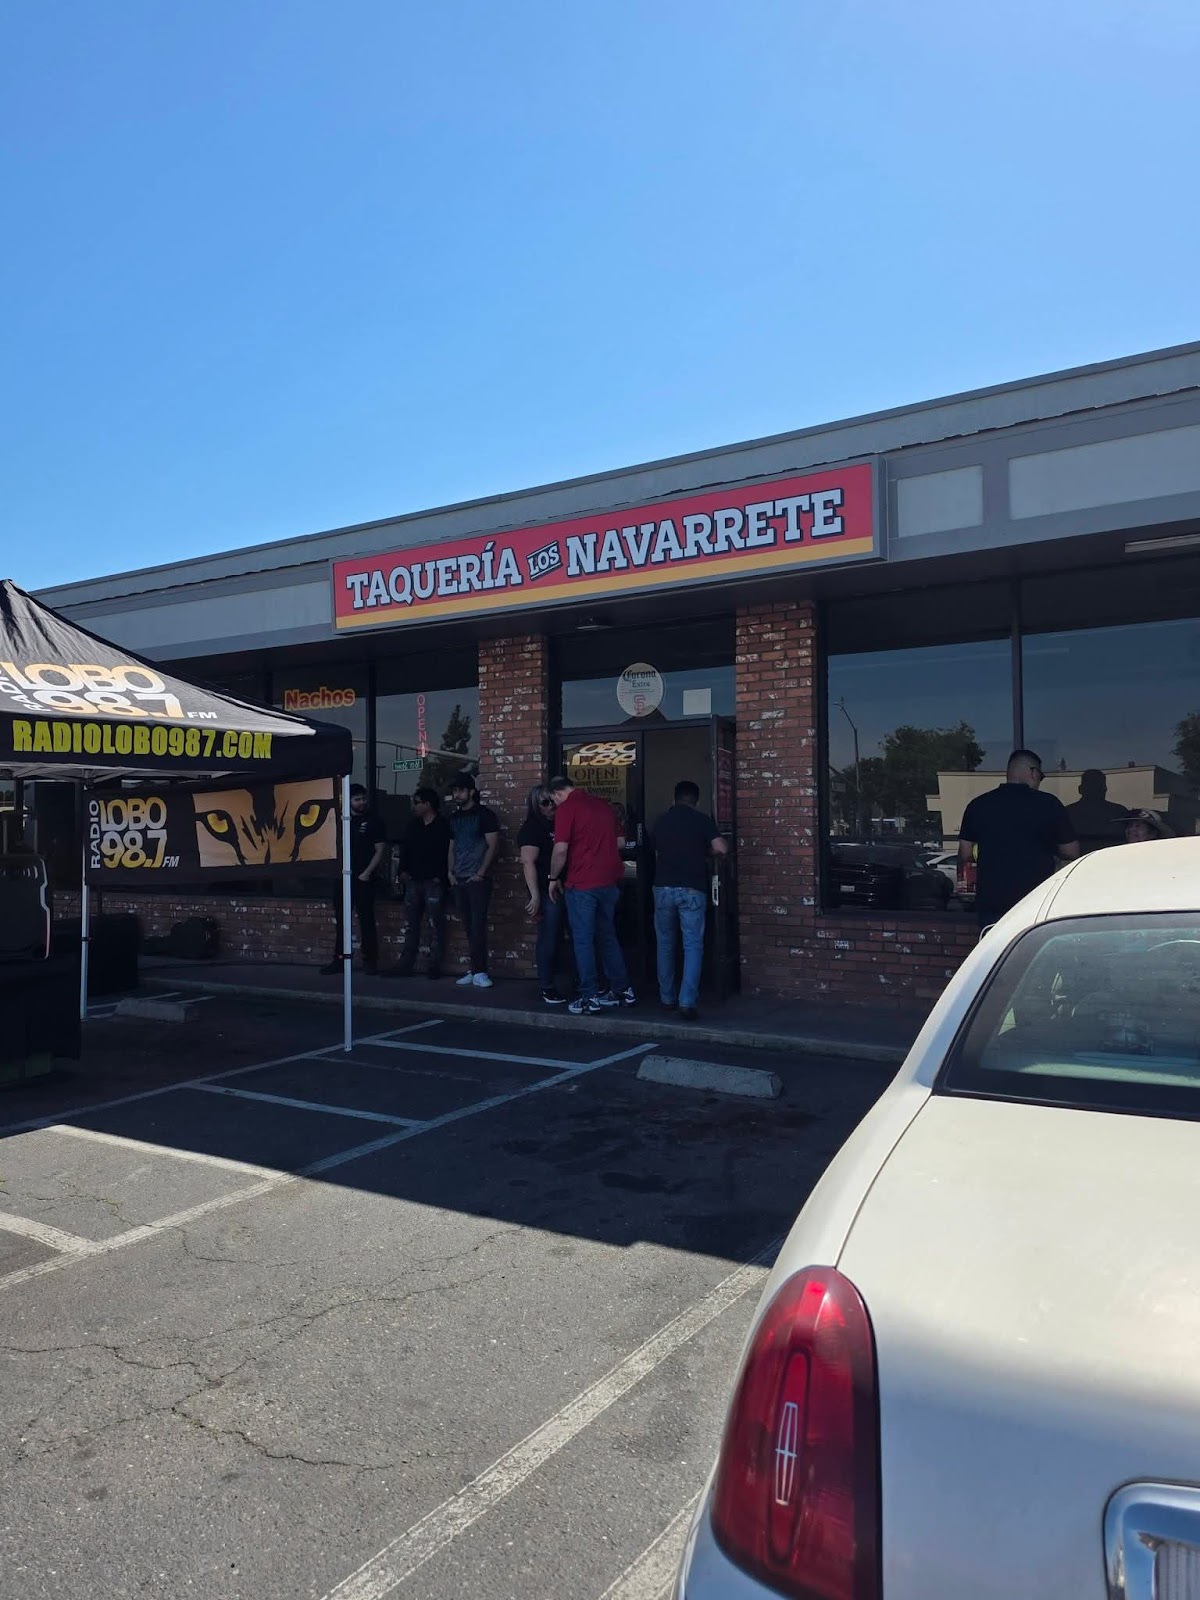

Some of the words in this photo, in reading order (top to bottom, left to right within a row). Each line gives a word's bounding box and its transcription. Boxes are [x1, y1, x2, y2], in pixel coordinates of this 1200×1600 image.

[346, 541, 523, 609] TAQUERÍA
[527, 543, 561, 576] LOS
[567, 488, 845, 577] NAVARRETE
[0, 662, 165, 693] LOBO
[0, 670, 52, 711] RADI
[623, 669, 656, 683] Corona
[632, 680, 650, 688] Extra
[33, 690, 184, 718] 98.7
[188, 711, 218, 719] FM
[284, 686, 356, 711] Nachos
[417, 694, 428, 742] OPEN
[13, 720, 273, 760] RADIOLOBO987.COM
[574, 767, 619, 781] OPEN!
[100, 796, 168, 832] LOBO
[89, 800, 101, 869] RADIO
[100, 829, 168, 869] 98.7
[162, 855, 180, 867] FM
